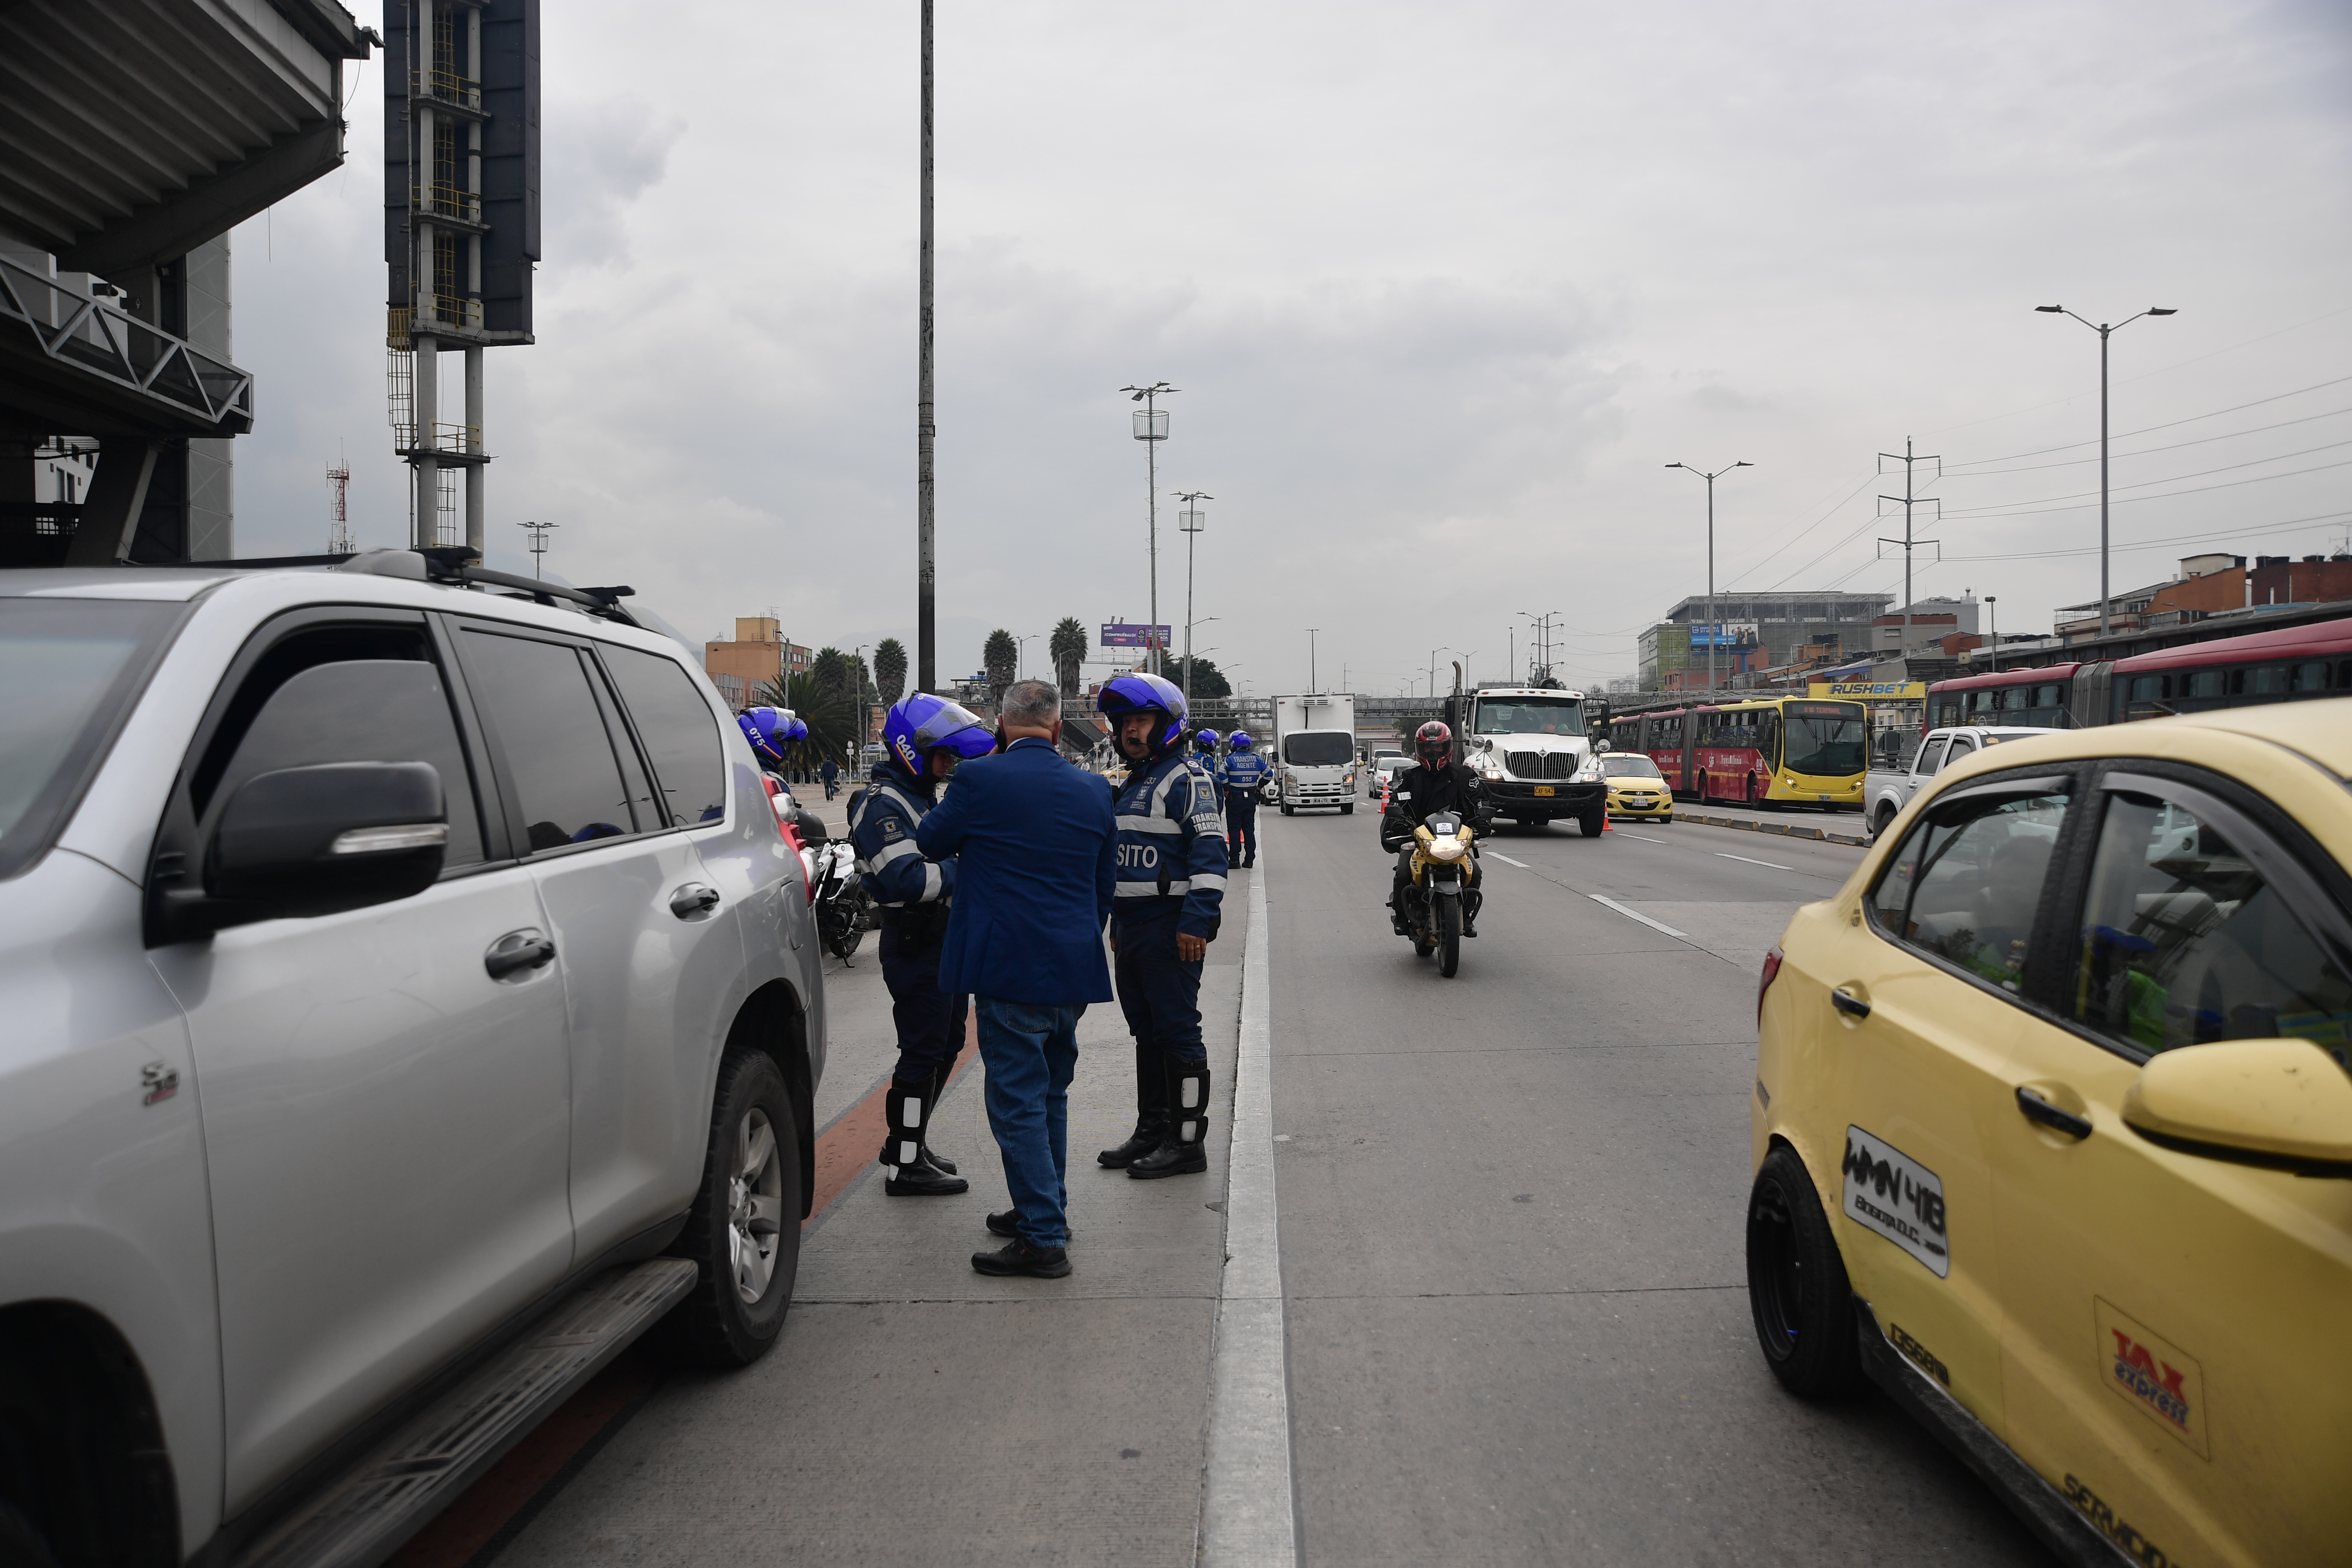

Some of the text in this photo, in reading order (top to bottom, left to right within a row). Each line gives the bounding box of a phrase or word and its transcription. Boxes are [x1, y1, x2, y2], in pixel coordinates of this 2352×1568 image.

[1831, 684, 1909, 694] RUSHBET
[749, 727, 765, 746] 075
[896, 734, 916, 761] 040
[2111, 1326, 2187, 1406] TAX
[2115, 1361, 2187, 1425] express
